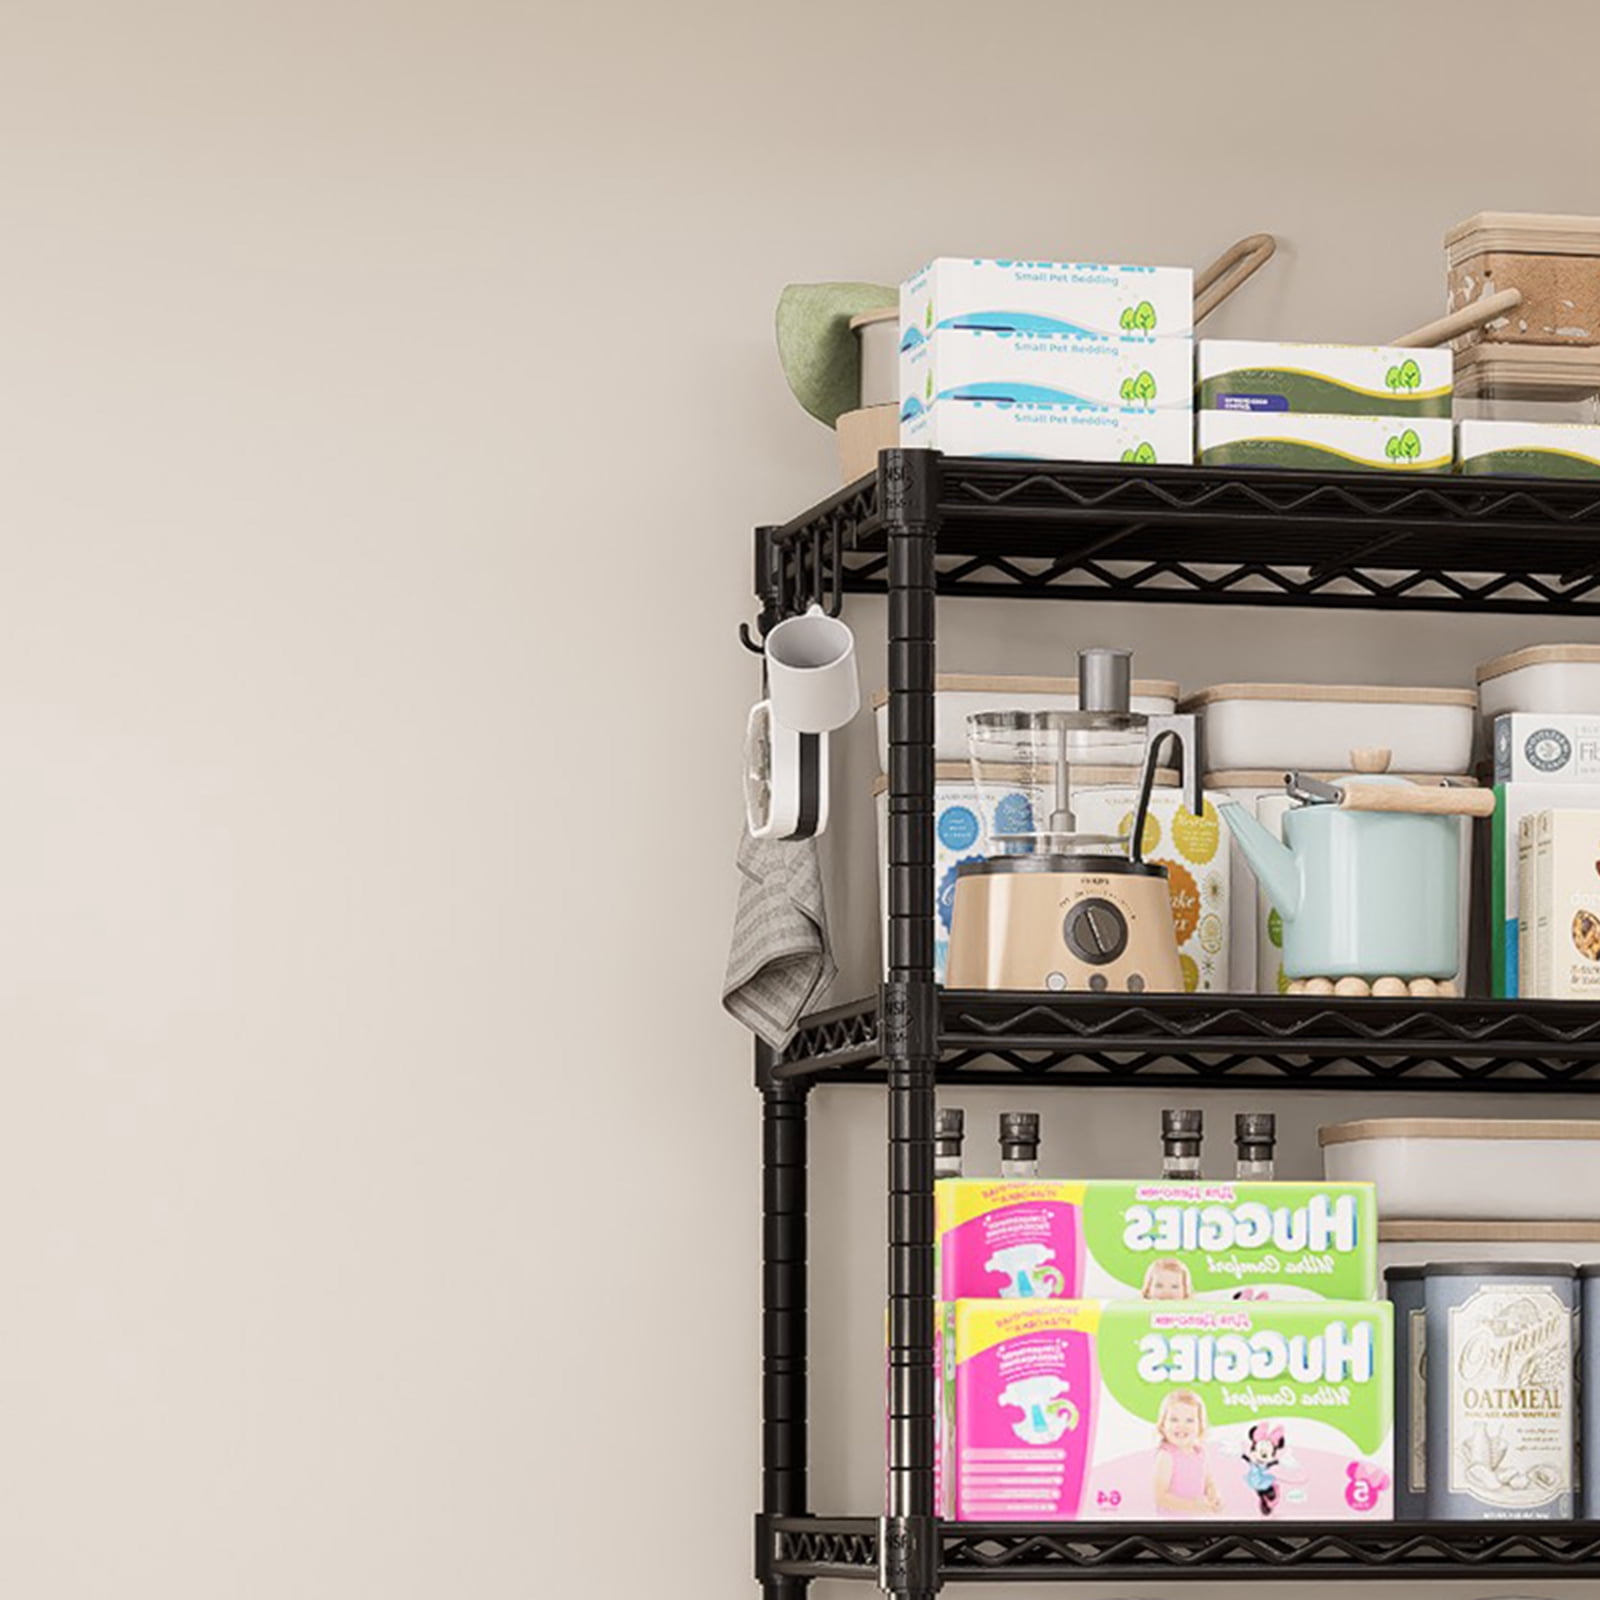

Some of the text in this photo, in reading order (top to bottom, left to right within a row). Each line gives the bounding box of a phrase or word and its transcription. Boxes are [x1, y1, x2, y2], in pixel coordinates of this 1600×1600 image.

[1014, 272, 1119, 286] Small Pet Bedding
[1014, 342, 1119, 356] Small Pet Bedding
[1014, 413, 1119, 428] Small Pet Bedding
[1459, 1312, 1558, 1382] Organic
[1463, 1388, 1562, 1410] OATMEAL
